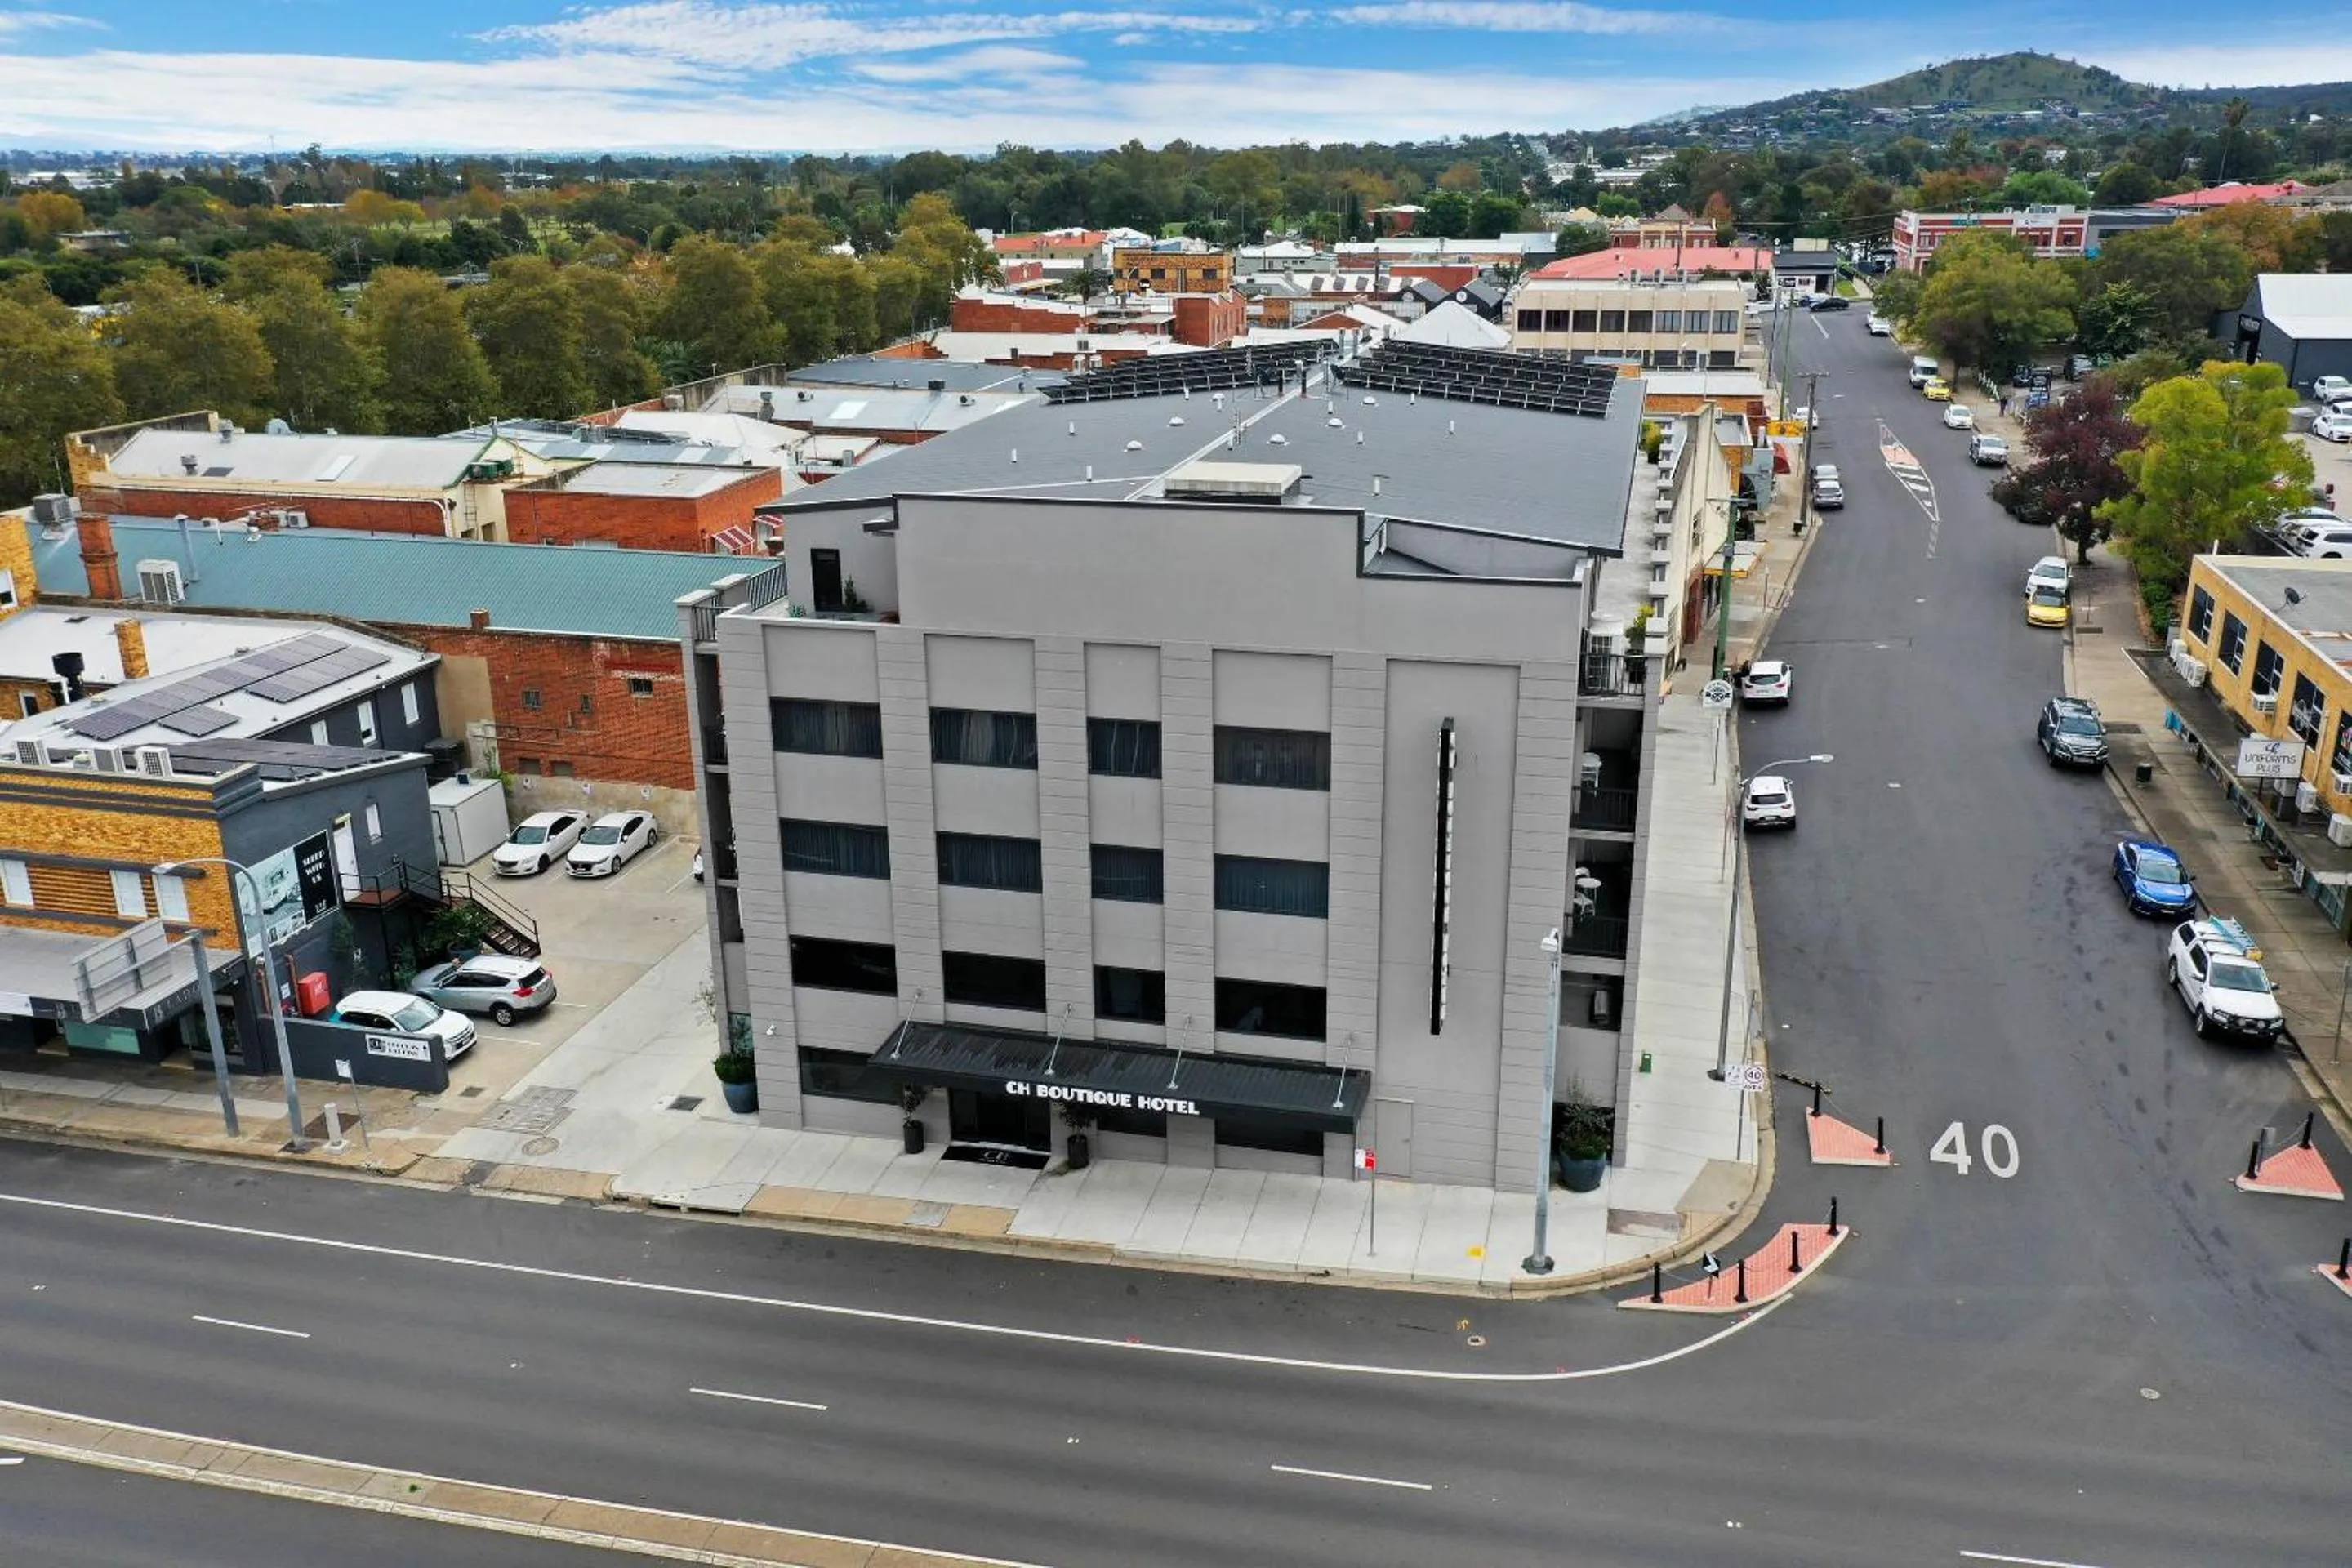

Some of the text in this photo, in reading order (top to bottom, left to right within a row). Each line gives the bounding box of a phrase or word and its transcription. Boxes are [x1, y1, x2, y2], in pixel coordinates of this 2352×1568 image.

[2244, 753, 2296, 764] UNIFORMS
[2256, 764, 2281, 773] PLUS
[1748, 1071, 1762, 1080] 40
[1005, 1080, 1200, 1116] CH BOUTIQUE HOTEL
[1930, 1120, 2020, 1178] 40
